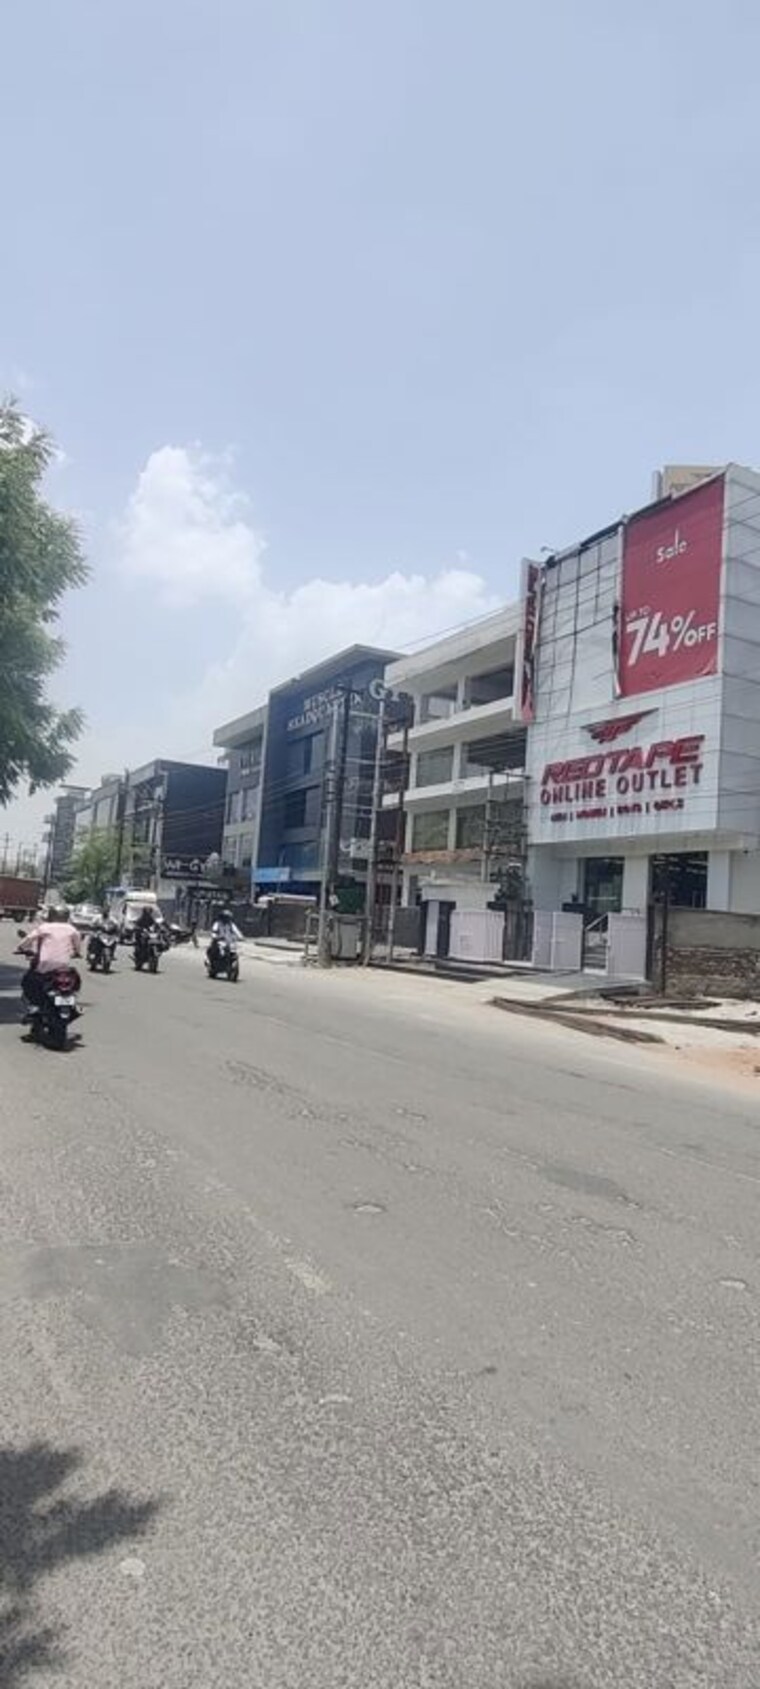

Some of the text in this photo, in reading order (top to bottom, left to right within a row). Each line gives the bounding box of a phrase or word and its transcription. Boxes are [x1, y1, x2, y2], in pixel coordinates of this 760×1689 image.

[655, 527, 688, 564] sale
[540, 734, 705, 786] REDTAPE
[540, 763, 704, 806] ONLINE OUTLET
